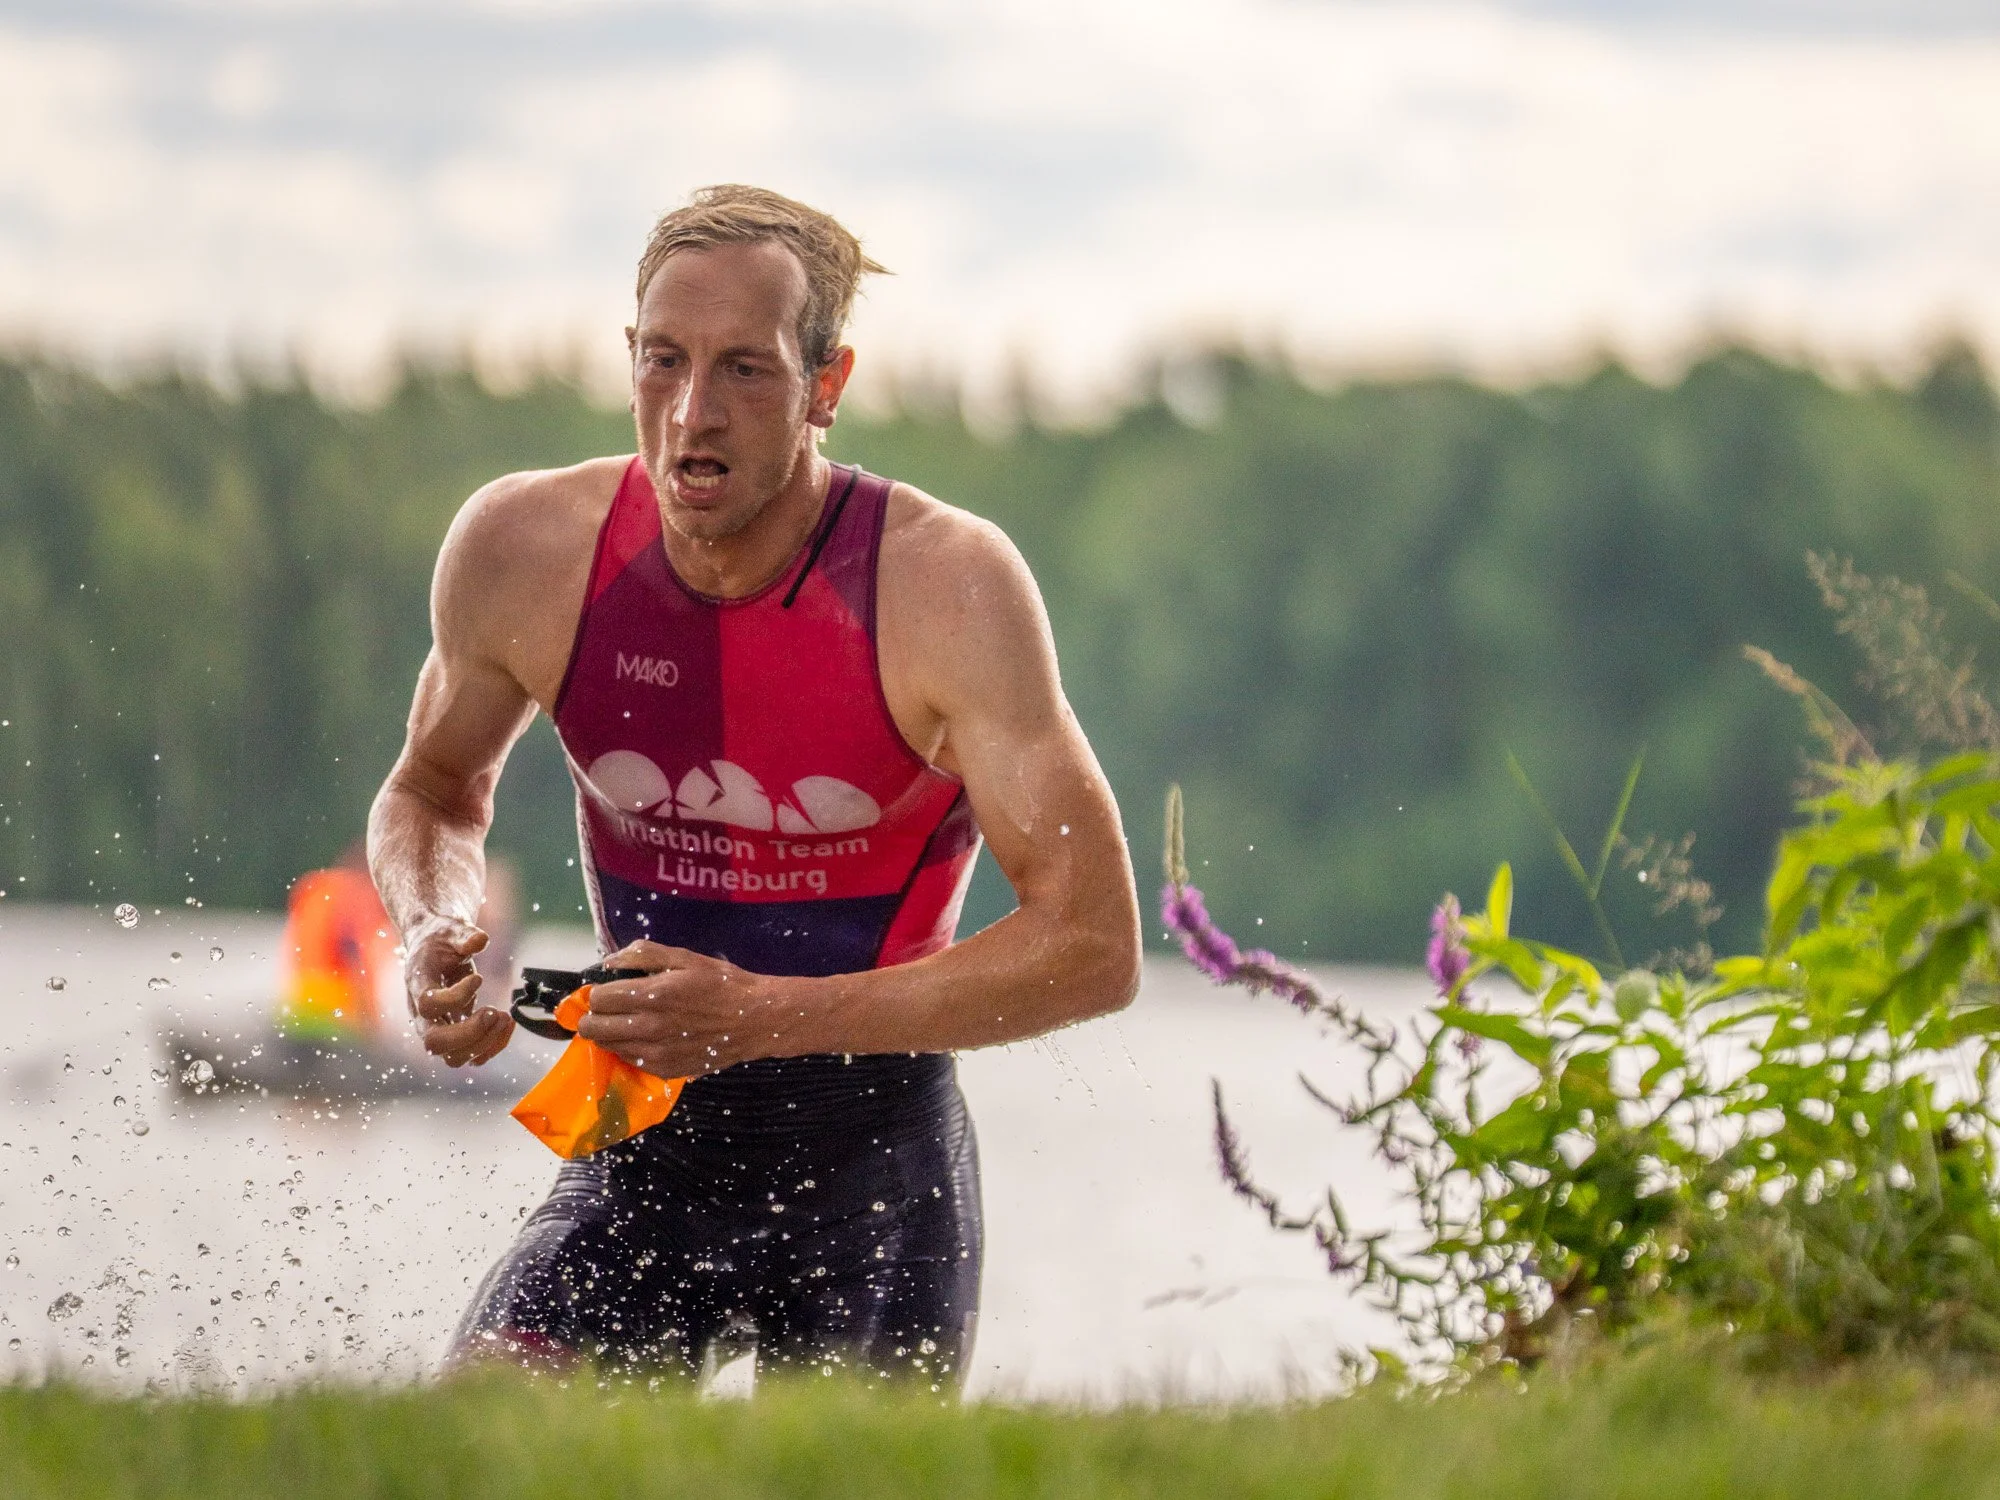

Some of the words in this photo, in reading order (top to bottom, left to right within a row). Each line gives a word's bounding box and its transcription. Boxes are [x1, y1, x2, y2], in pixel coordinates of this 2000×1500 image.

[614, 650, 679, 688] MAKO
[768, 837, 870, 861] Team
[656, 853, 828, 895] Lüneburg
